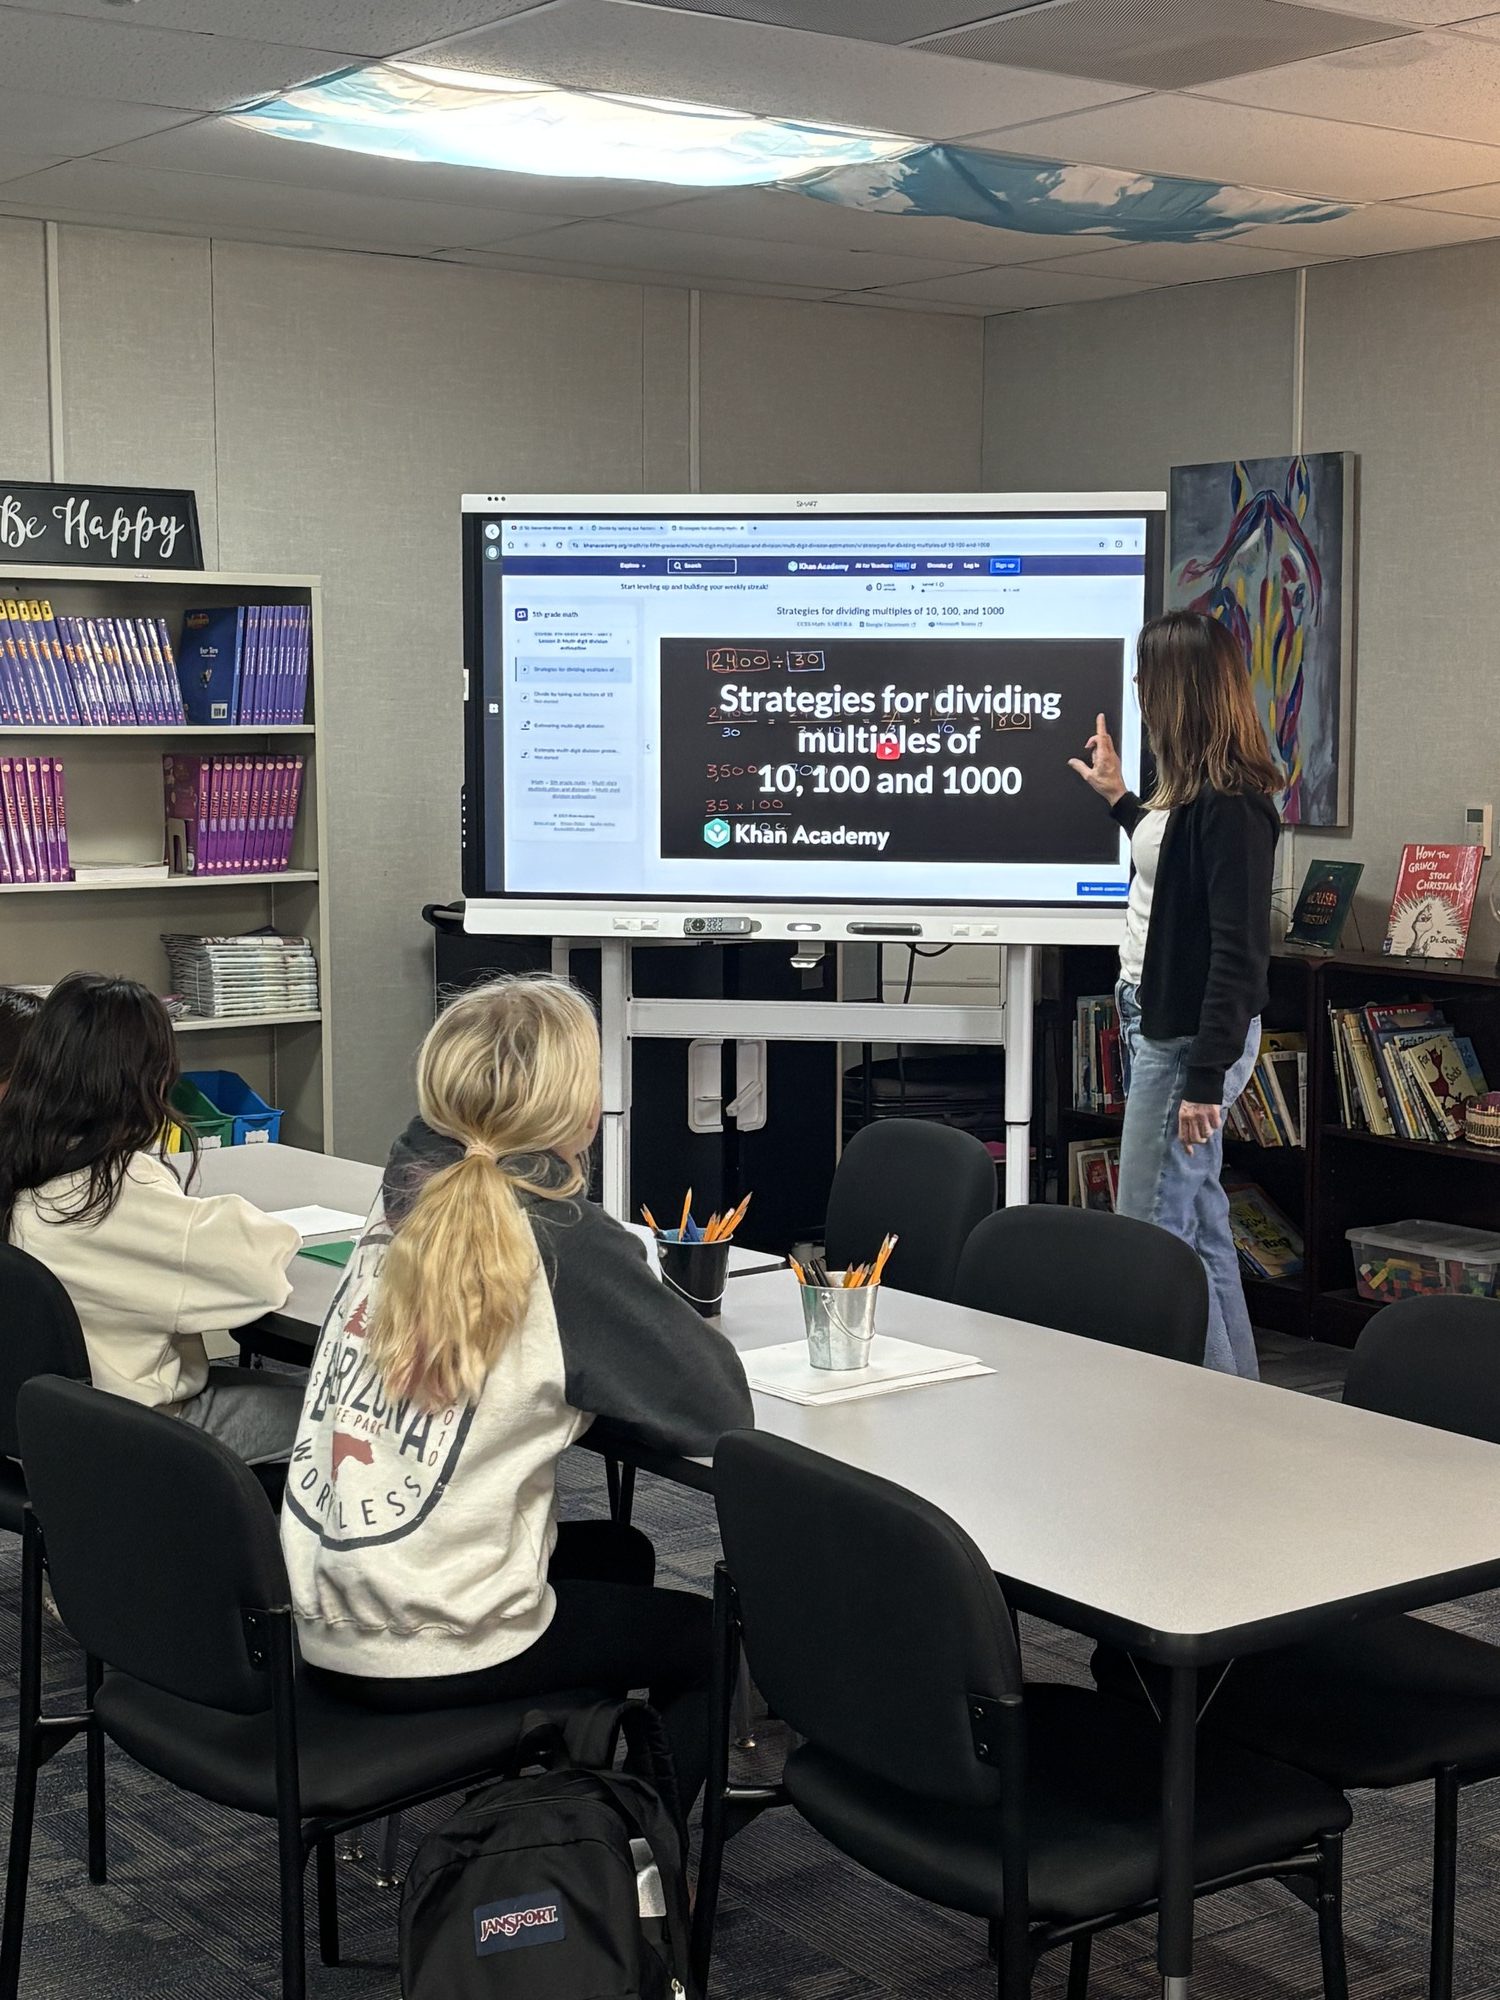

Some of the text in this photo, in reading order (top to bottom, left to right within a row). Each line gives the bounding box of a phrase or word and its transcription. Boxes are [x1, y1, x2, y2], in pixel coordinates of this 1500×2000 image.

[0, 495, 185, 559] Be Happy
[817, 563, 849, 572] Academy
[637, 583, 660, 591] leveling
[684, 583, 708, 591] building
[724, 583, 746, 591] weekly
[876, 583, 882, 591] 0
[776, 606, 1005, 616] Strategies for dividing multiples of 10, 100, and 1000
[795, 653, 819, 667] 30
[720, 684, 1062, 720] Strategies for dividing
[722, 727, 741, 738] 30
[948, 725, 982, 755] of
[758, 764, 1023, 797] 10, 100 and 1000
[706, 800, 729, 812] 35
[751, 800, 784, 811] 100
[735, 824, 890, 850] Khan Academy
[1408, 861, 1438, 873] GRINCH
[1428, 872, 1453, 880] STOLE
[1441, 936, 1458, 945] Seuss
[427, 1398, 458, 1467] 010
[339, 1475, 422, 1529] LESS
[481, 1906, 558, 1942] JANSPORT
